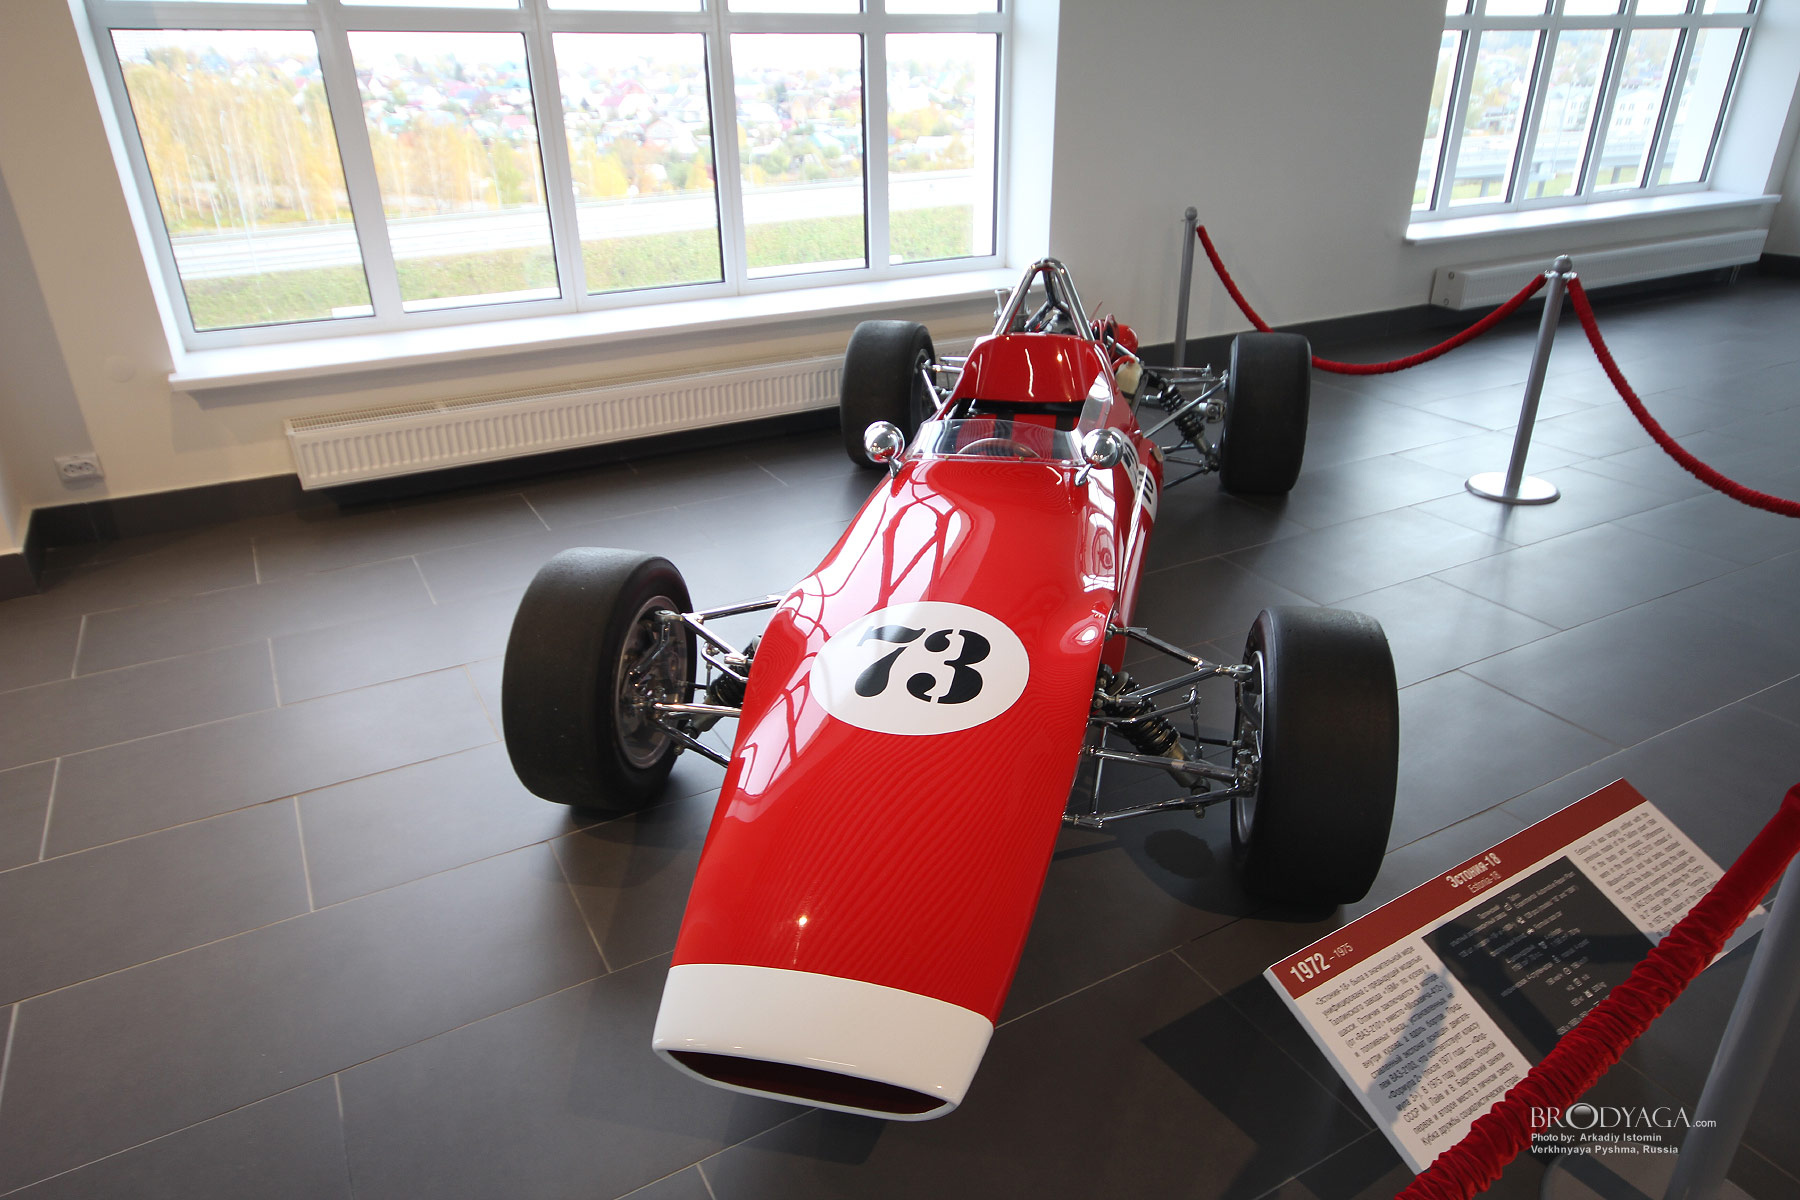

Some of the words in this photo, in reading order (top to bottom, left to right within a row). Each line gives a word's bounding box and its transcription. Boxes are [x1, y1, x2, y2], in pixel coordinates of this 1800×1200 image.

[854, 624, 991, 704] 73
[1446, 852, 1501, 887] Эстония-18
[1467, 870, 1501, 893] Estonia-18
[1290, 952, 1330, 982] 1972
[1333, 942, 1353, 957] 1975
[1349, 974, 1365, 986] была
[1367, 952, 1401, 975] значительной
[1400, 945, 1415, 956] мере
[1322, 989, 1364, 1018] унифицирована
[1367, 967, 1399, 989] предыдущей
[1399, 955, 1422, 971] моделью
[1356, 1008, 1380, 1024] Отличия
[1380, 987, 1414, 1011] заключаются
[1363, 992, 1383, 1006] завода
[1407, 967, 1426, 980] кузову
[1385, 1008, 1405, 1023] вместо
[1360, 1033, 1389, 1053] топливных
[1361, 1053, 1381, 1068] внутри
[1408, 1026, 1426, 1038] вдоль
[1370, 1054, 1402, 1079] ставленный
[1402, 1039, 1426, 1058] экспонат
[1378, 1079, 1391, 1089] лем
[1417, 1054, 1428, 1063] что
[1426, 1032, 1462, 1058] соответствует
[1461, 1021, 1480, 1035] классу
[1441, 1069, 1456, 1080] году
[1454, 1056, 1475, 1072] лидеры
[1474, 1040, 1496, 1058] сборной
[1451, 1046, 1466, 1057] года
[1403, 1107, 1419, 1123] СССР
[1486, 1051, 1505, 1066] заняли
[1413, 1117, 1434, 1134] первое
[1437, 1101, 1458, 1117] второе
[1456, 1089, 1474, 1103] место
[1477, 1073, 1498, 1089] личном
[1496, 1061, 1514, 1076] зачете
[1421, 1130, 1440, 1145] Кубка
[1438, 1116, 1461, 1135] дружбы
